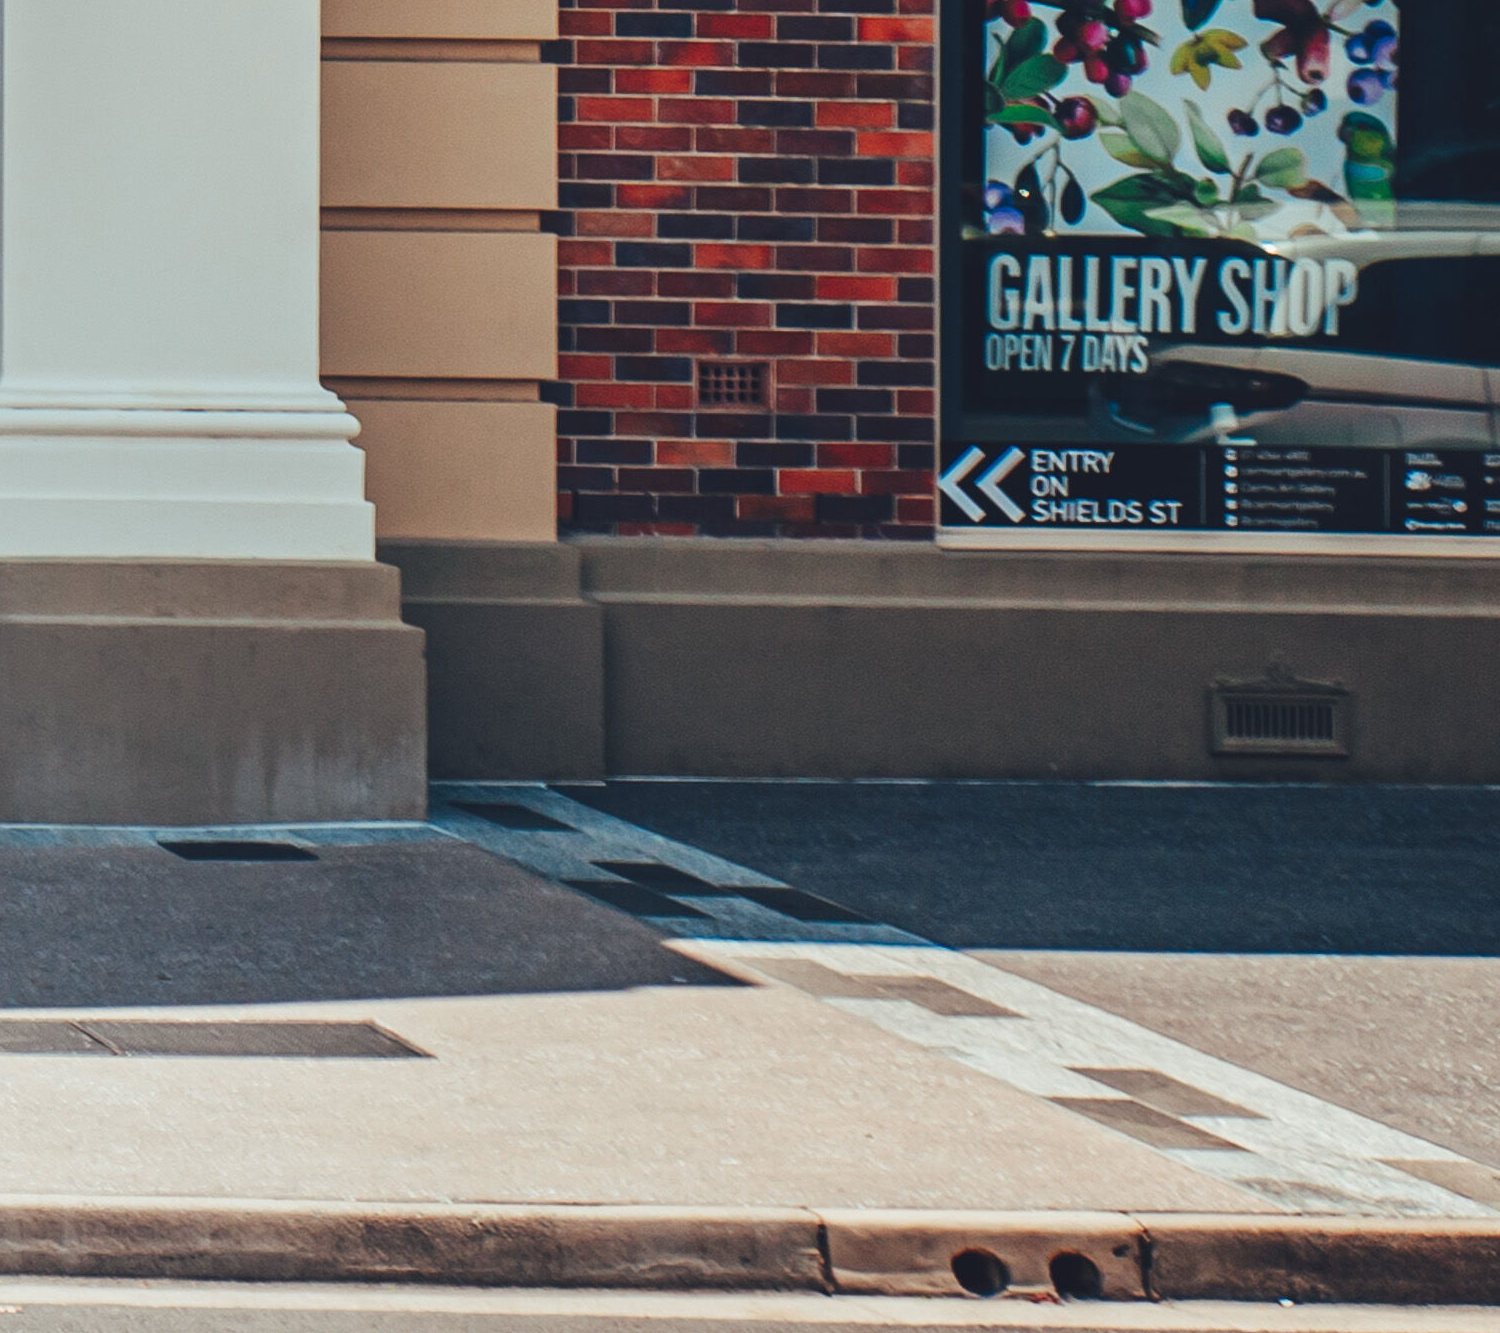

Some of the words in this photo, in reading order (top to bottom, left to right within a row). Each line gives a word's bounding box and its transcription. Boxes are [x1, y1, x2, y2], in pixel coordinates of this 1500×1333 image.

[988, 254, 1207, 333] GALLERY
[1217, 257, 1358, 335] SHOP
[985, 333, 1053, 371] OPEN
[1060, 334, 1073, 371] 7
[1082, 334, 1148, 373] DAYS
[1031, 449, 1115, 474] ENTRY
[1030, 475, 1068, 497] ON
[1030, 498, 1144, 523] SHIELDS
[1148, 502, 1182, 524] ST
